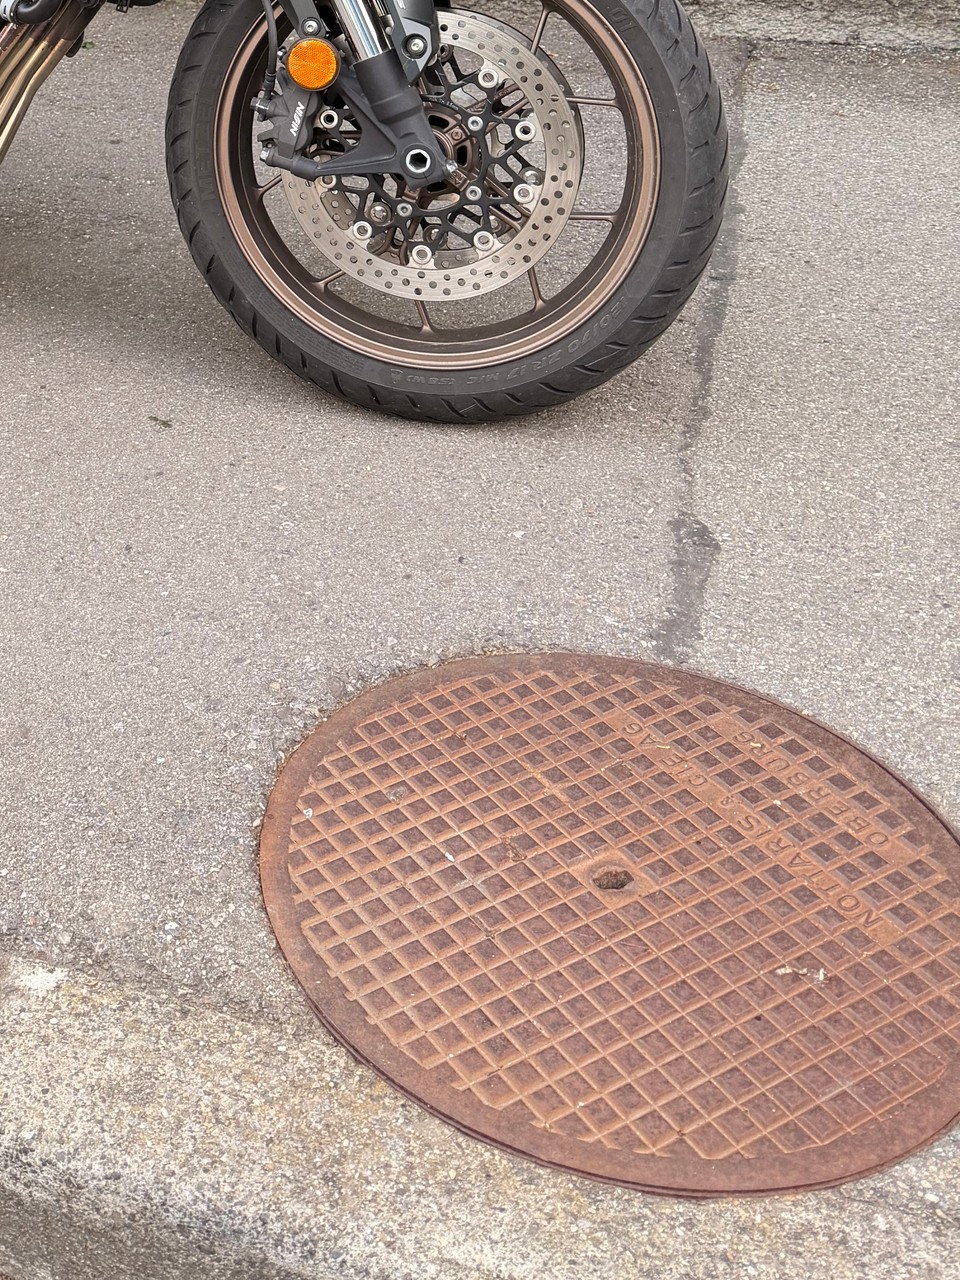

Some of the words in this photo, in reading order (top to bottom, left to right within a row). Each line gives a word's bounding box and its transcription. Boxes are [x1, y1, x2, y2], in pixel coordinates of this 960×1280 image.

[620, 721, 659, 748] AG
[733, 731, 890, 846] OBERBURG
[738, 814, 882, 930] NOTTARIS
